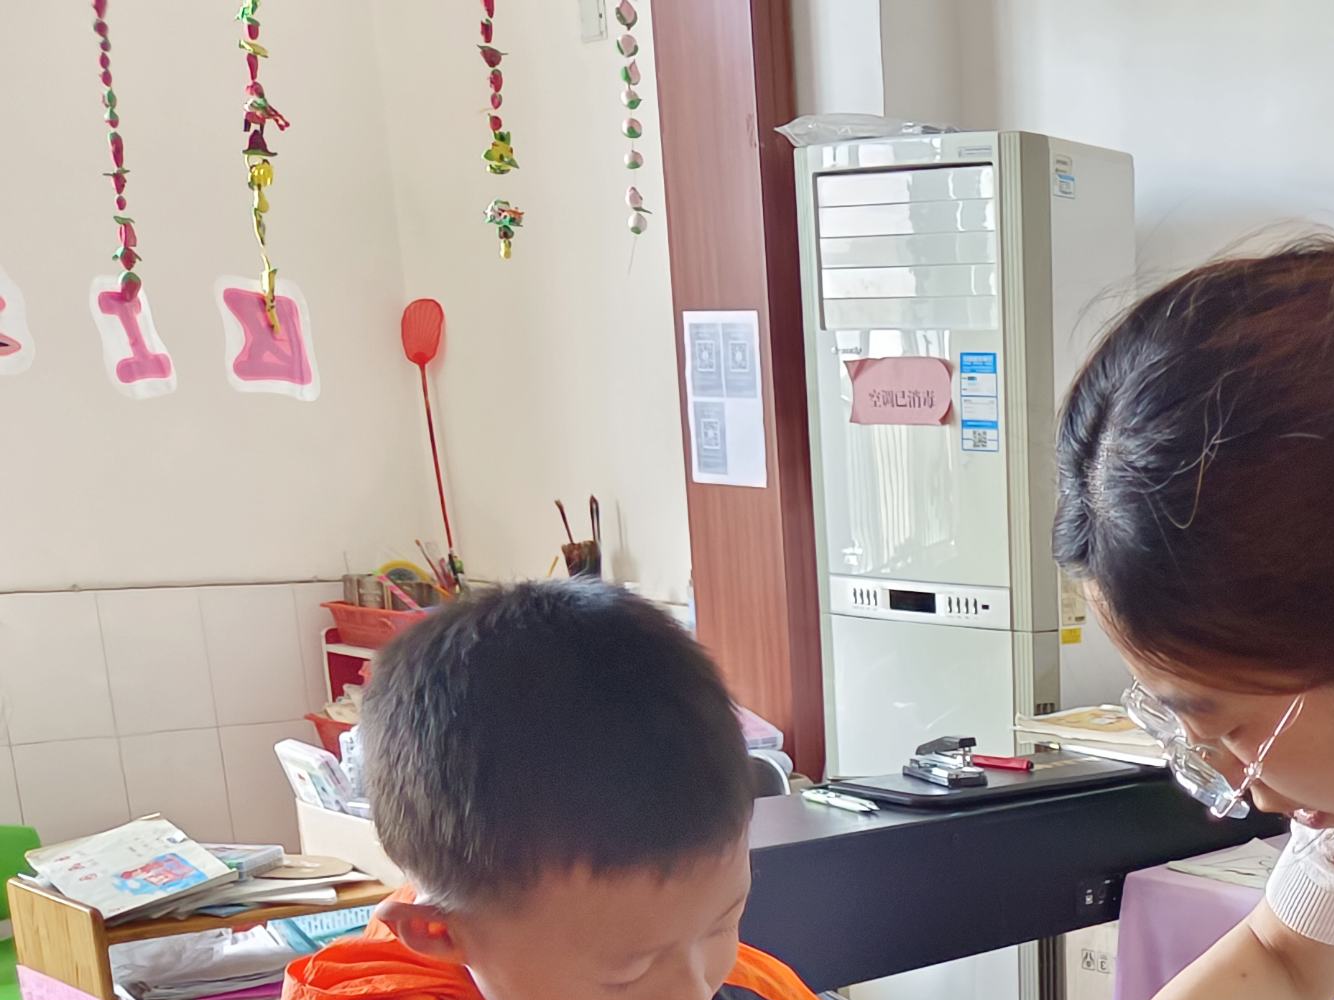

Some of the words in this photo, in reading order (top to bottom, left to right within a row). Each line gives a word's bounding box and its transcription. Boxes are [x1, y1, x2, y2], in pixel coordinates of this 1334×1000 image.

[868, 389, 936, 409] 空调已消毒
